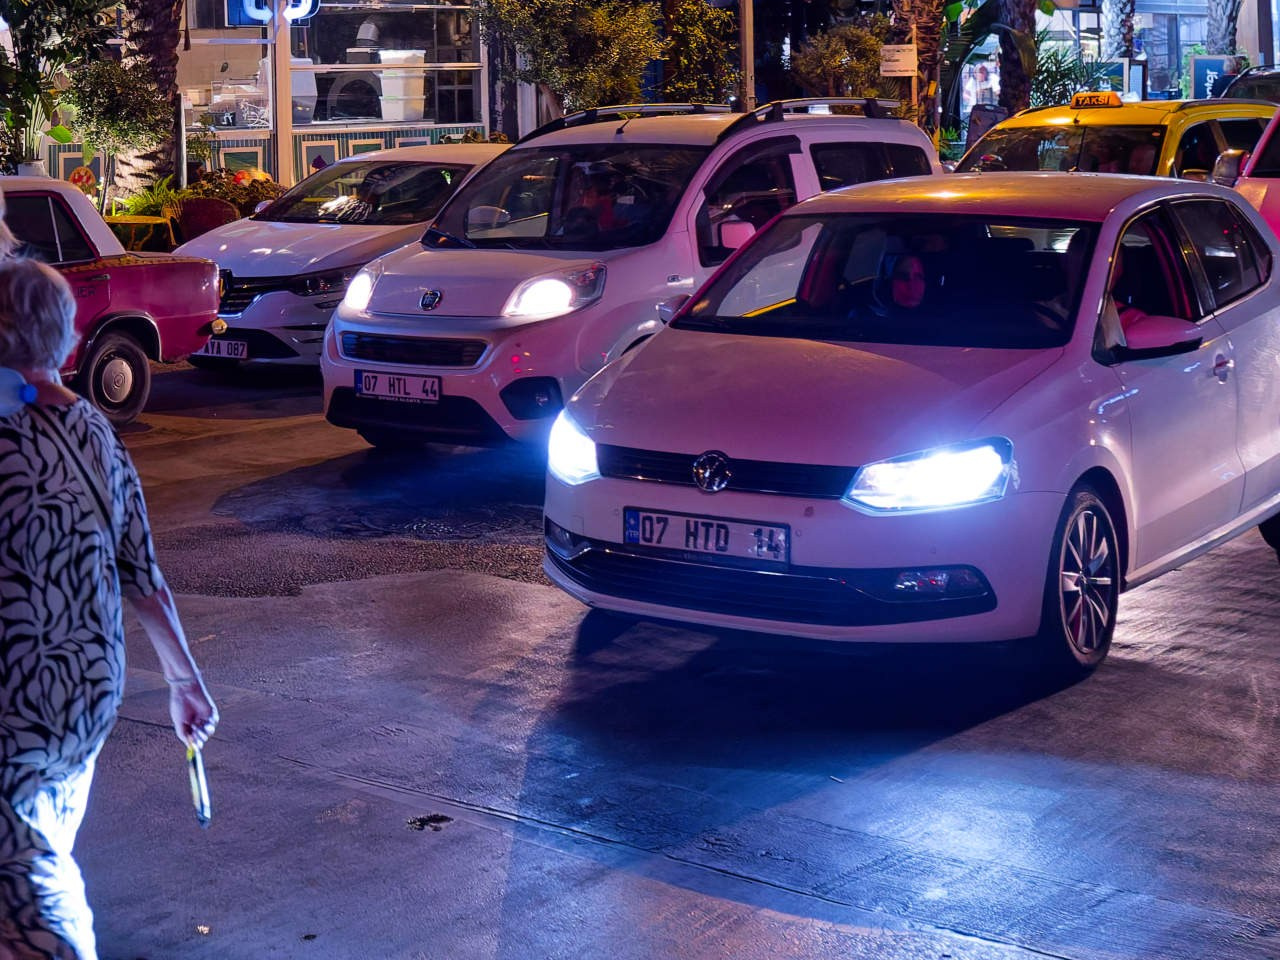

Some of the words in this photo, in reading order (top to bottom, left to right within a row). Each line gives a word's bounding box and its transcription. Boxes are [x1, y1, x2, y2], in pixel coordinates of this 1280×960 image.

[227, 342, 246, 357] 087
[364, 371, 378, 392] 07
[388, 376, 411, 396] HTL
[421, 380, 438, 398] 44
[641, 515, 669, 544] 07
[685, 519, 730, 552] HTD
